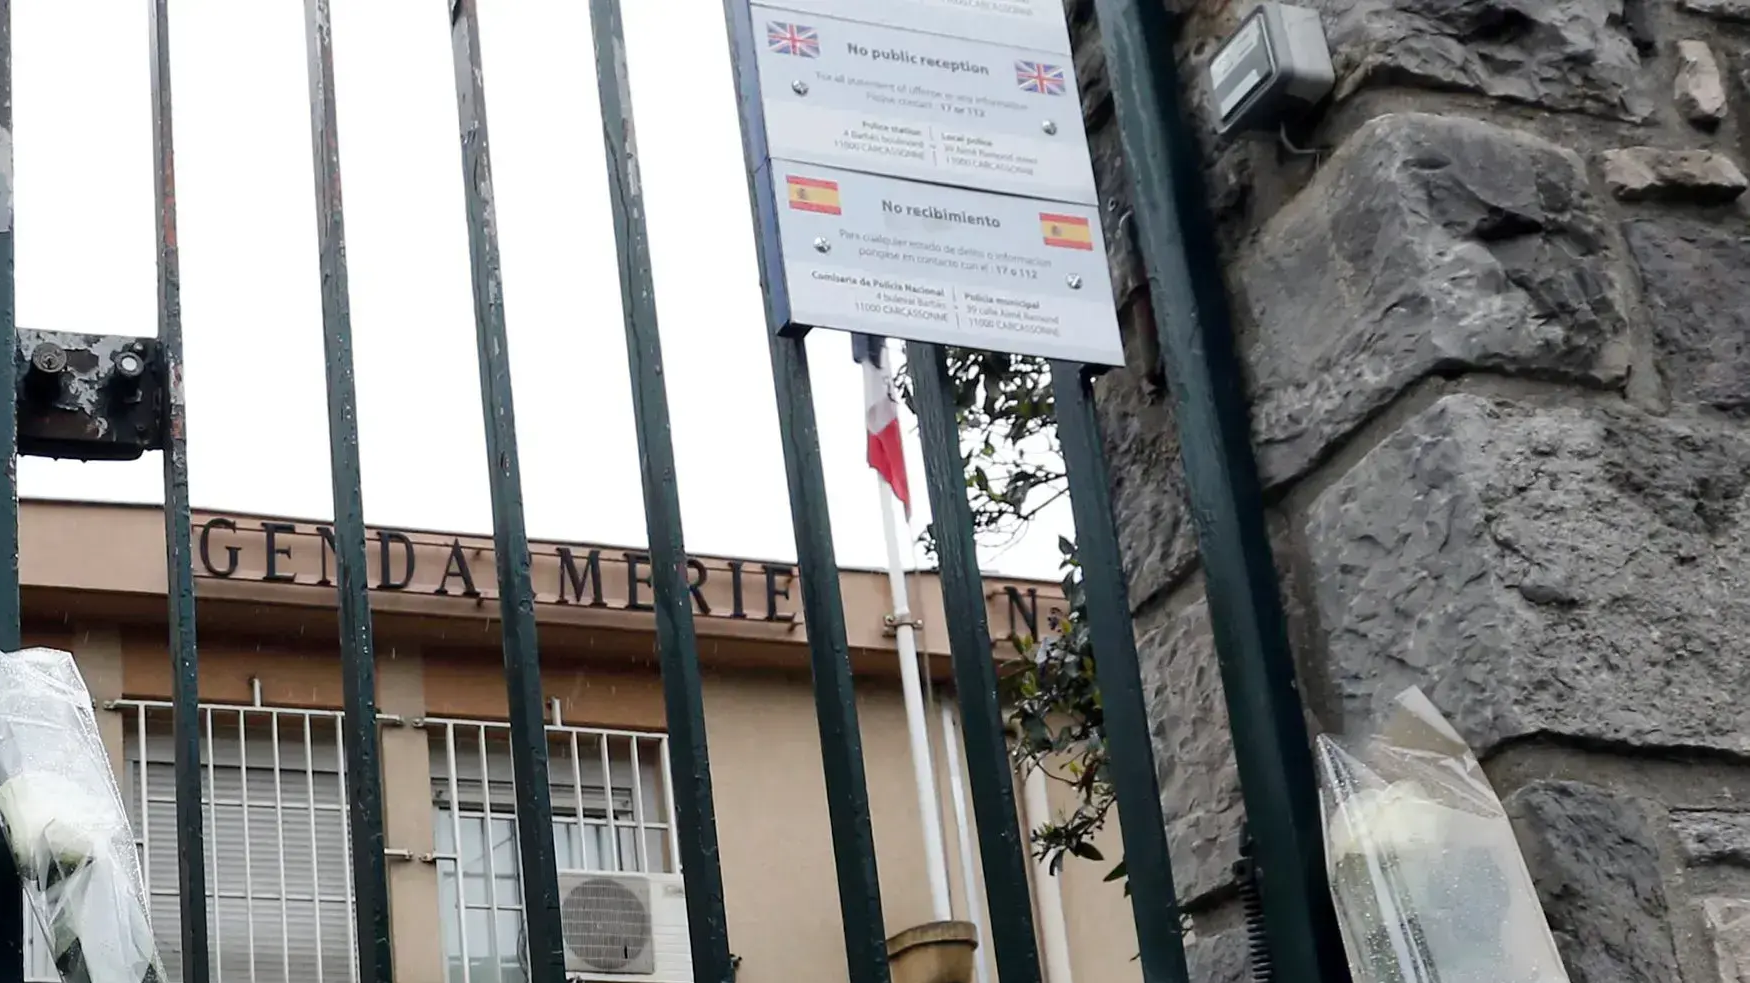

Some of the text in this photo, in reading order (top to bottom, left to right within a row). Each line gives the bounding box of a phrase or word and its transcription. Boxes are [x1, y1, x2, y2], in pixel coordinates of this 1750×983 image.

[847, 42, 989, 76] No public reception
[882, 200, 1000, 228] No recibimiento
[200, 518, 796, 622] GENDAMERIE
